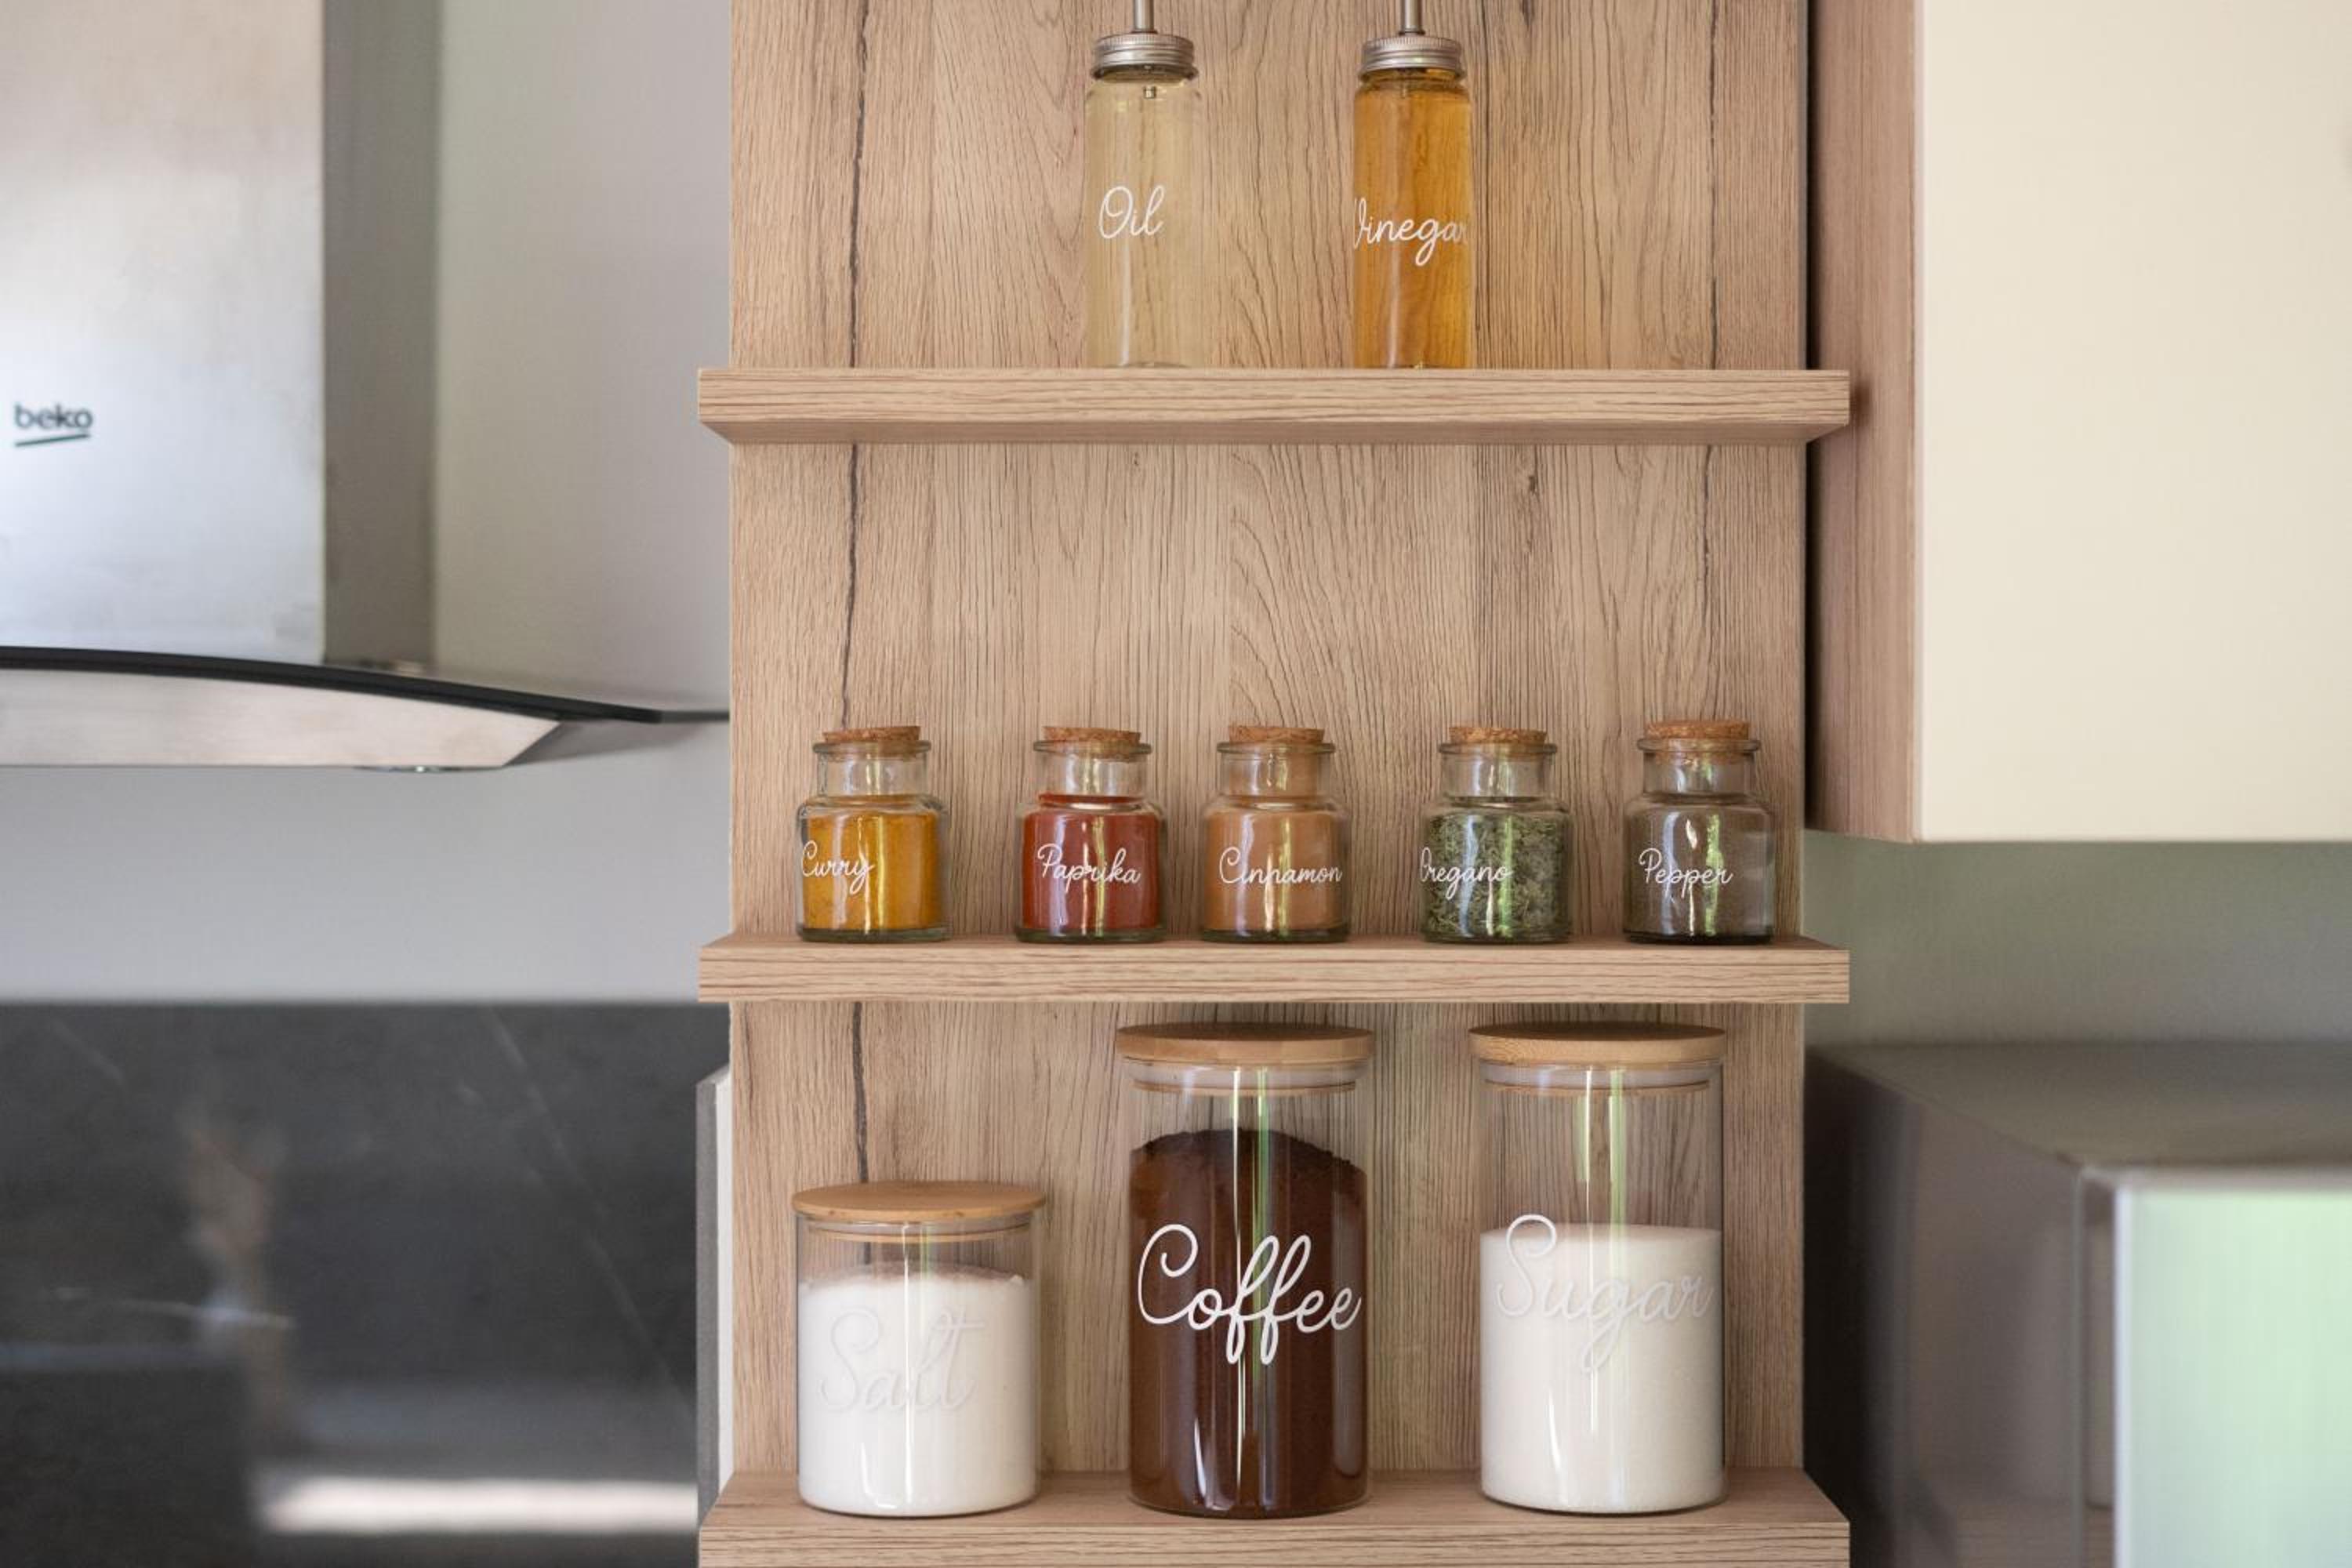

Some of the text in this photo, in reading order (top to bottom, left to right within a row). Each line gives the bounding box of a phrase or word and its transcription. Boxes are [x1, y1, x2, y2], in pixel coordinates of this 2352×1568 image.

[1098, 186, 1165, 238] Oil
[14, 404, 93, 429] beko
[801, 840, 876, 895] Curry
[1036, 843, 1142, 894] Paprika
[1219, 846, 1343, 884] Cinnamon
[1639, 848, 1733, 899] Pepper
[1138, 1223, 1362, 1365] Coffee
[1494, 1213, 1715, 1373] Sugar
[817, 1305, 985, 1414] Salt
